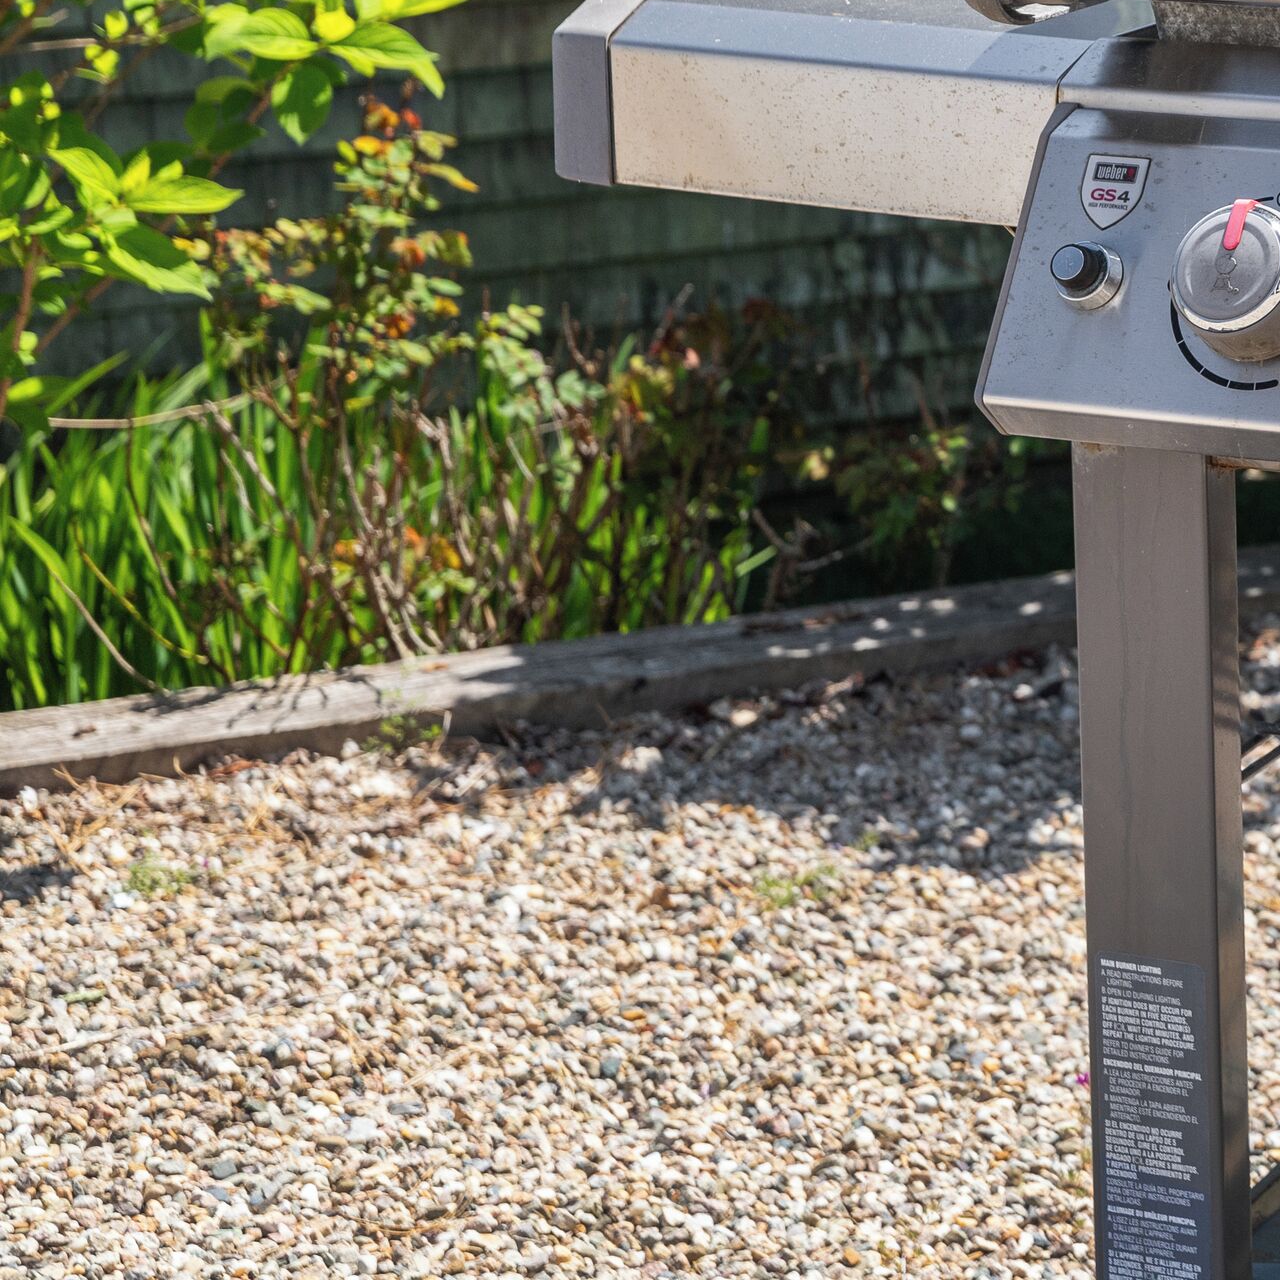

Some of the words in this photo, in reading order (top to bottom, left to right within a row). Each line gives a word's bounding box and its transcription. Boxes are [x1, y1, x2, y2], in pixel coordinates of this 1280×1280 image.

[1097, 163, 1127, 179] weber
[1091, 188, 1130, 203] GS4
[1098, 202, 1128, 211] PERFORMANCE
[1101, 959, 1115, 968] MAIN
[1116, 961, 1137, 971] BURNER
[1138, 964, 1162, 975] LIGHTING
[1106, 969, 1121, 978] READ
[1122, 971, 1162, 985] INSTRUCTIONS
[1163, 978, 1183, 988] BEFORE
[1102, 996, 1107, 1004] IF
[1108, 997, 1132, 1008] IGNITION
[1133, 1001, 1148, 1011] DOES
[1148, 1004, 1160, 1013] NOT
[1160, 1006, 1180, 1016] OCCUR
[1181, 1009, 1193, 1018] FOR
[1102, 1004, 1117, 1013] EACH
[1118, 1007, 1140, 1017] BURNER
[1148, 1012, 1160, 1020] FIVE
[1102, 1029, 1123, 1039] REPEAT
[1124, 1032, 1135, 1041] THE
[1135, 1034, 1161, 1045] LIGHTING
